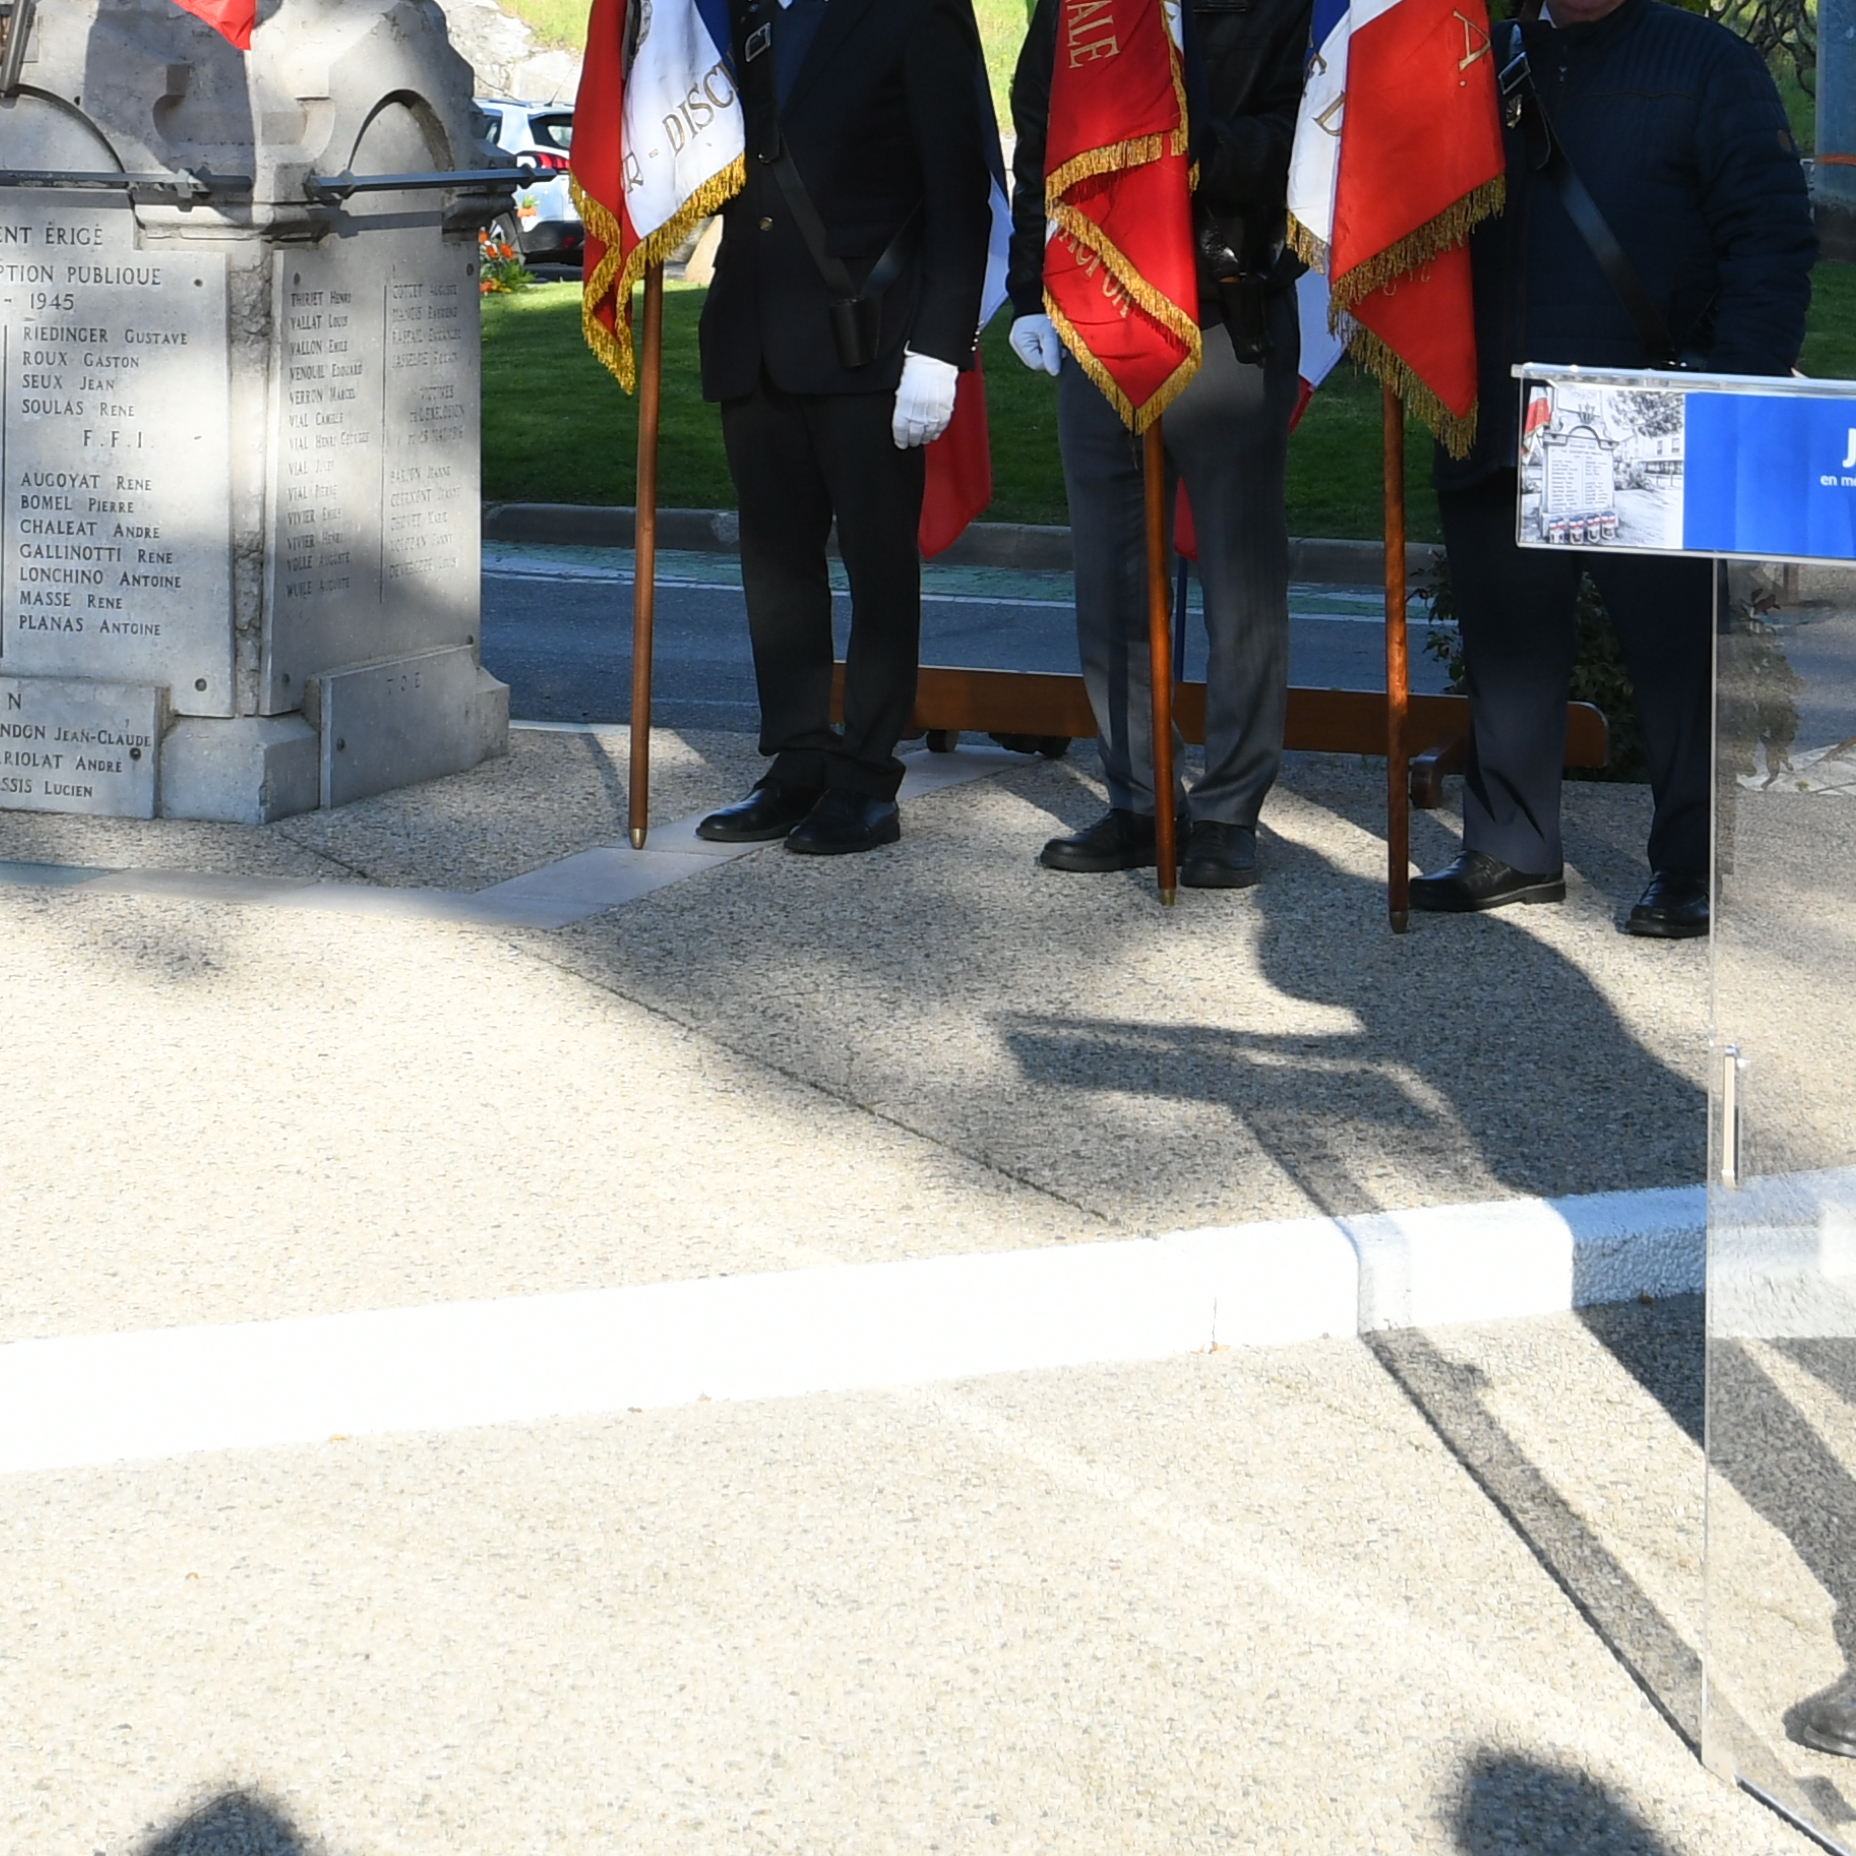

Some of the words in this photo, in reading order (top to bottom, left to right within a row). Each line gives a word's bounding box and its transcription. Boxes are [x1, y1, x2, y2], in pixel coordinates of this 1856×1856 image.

[67, 267, 161, 286] PUBLIQUE
[29, 293, 75, 310] 1945
[23, 327, 108, 344] RIEDINGER
[124, 329, 188, 345] GUSTAVE
[22, 352, 68, 367] ROUX
[84, 353, 139, 368] GASTON
[22, 375, 62, 390] SEUX
[80, 376, 115, 391] JEAN
[22, 399, 83, 416] SOULAS
[100, 403, 135, 417] RENE
[21, 473, 100, 489] AUGOYAT
[116, 476, 152, 491] RENE
[1820, 476, 1838, 486] en
[21, 496, 72, 511] BOMEL
[88, 499, 134, 513] PIERRE
[20, 519, 97, 536] CHALEAT
[113, 524, 159, 539] ANDRE
[20, 544, 121, 562] GALLINOTTI
[138, 549, 172, 564] RENE
[20, 568, 103, 586] LONCHINO
[119, 572, 181, 588] ANTOINE
[20, 591, 71, 607] MASSE
[87, 594, 122, 609] RENE
[19, 615, 83, 633] PLANAS
[100, 620, 160, 636] ANTOINE
[54, 727, 151, 747] JEAN-CLAUDE
[44, 780, 93, 797] LUCIEN
